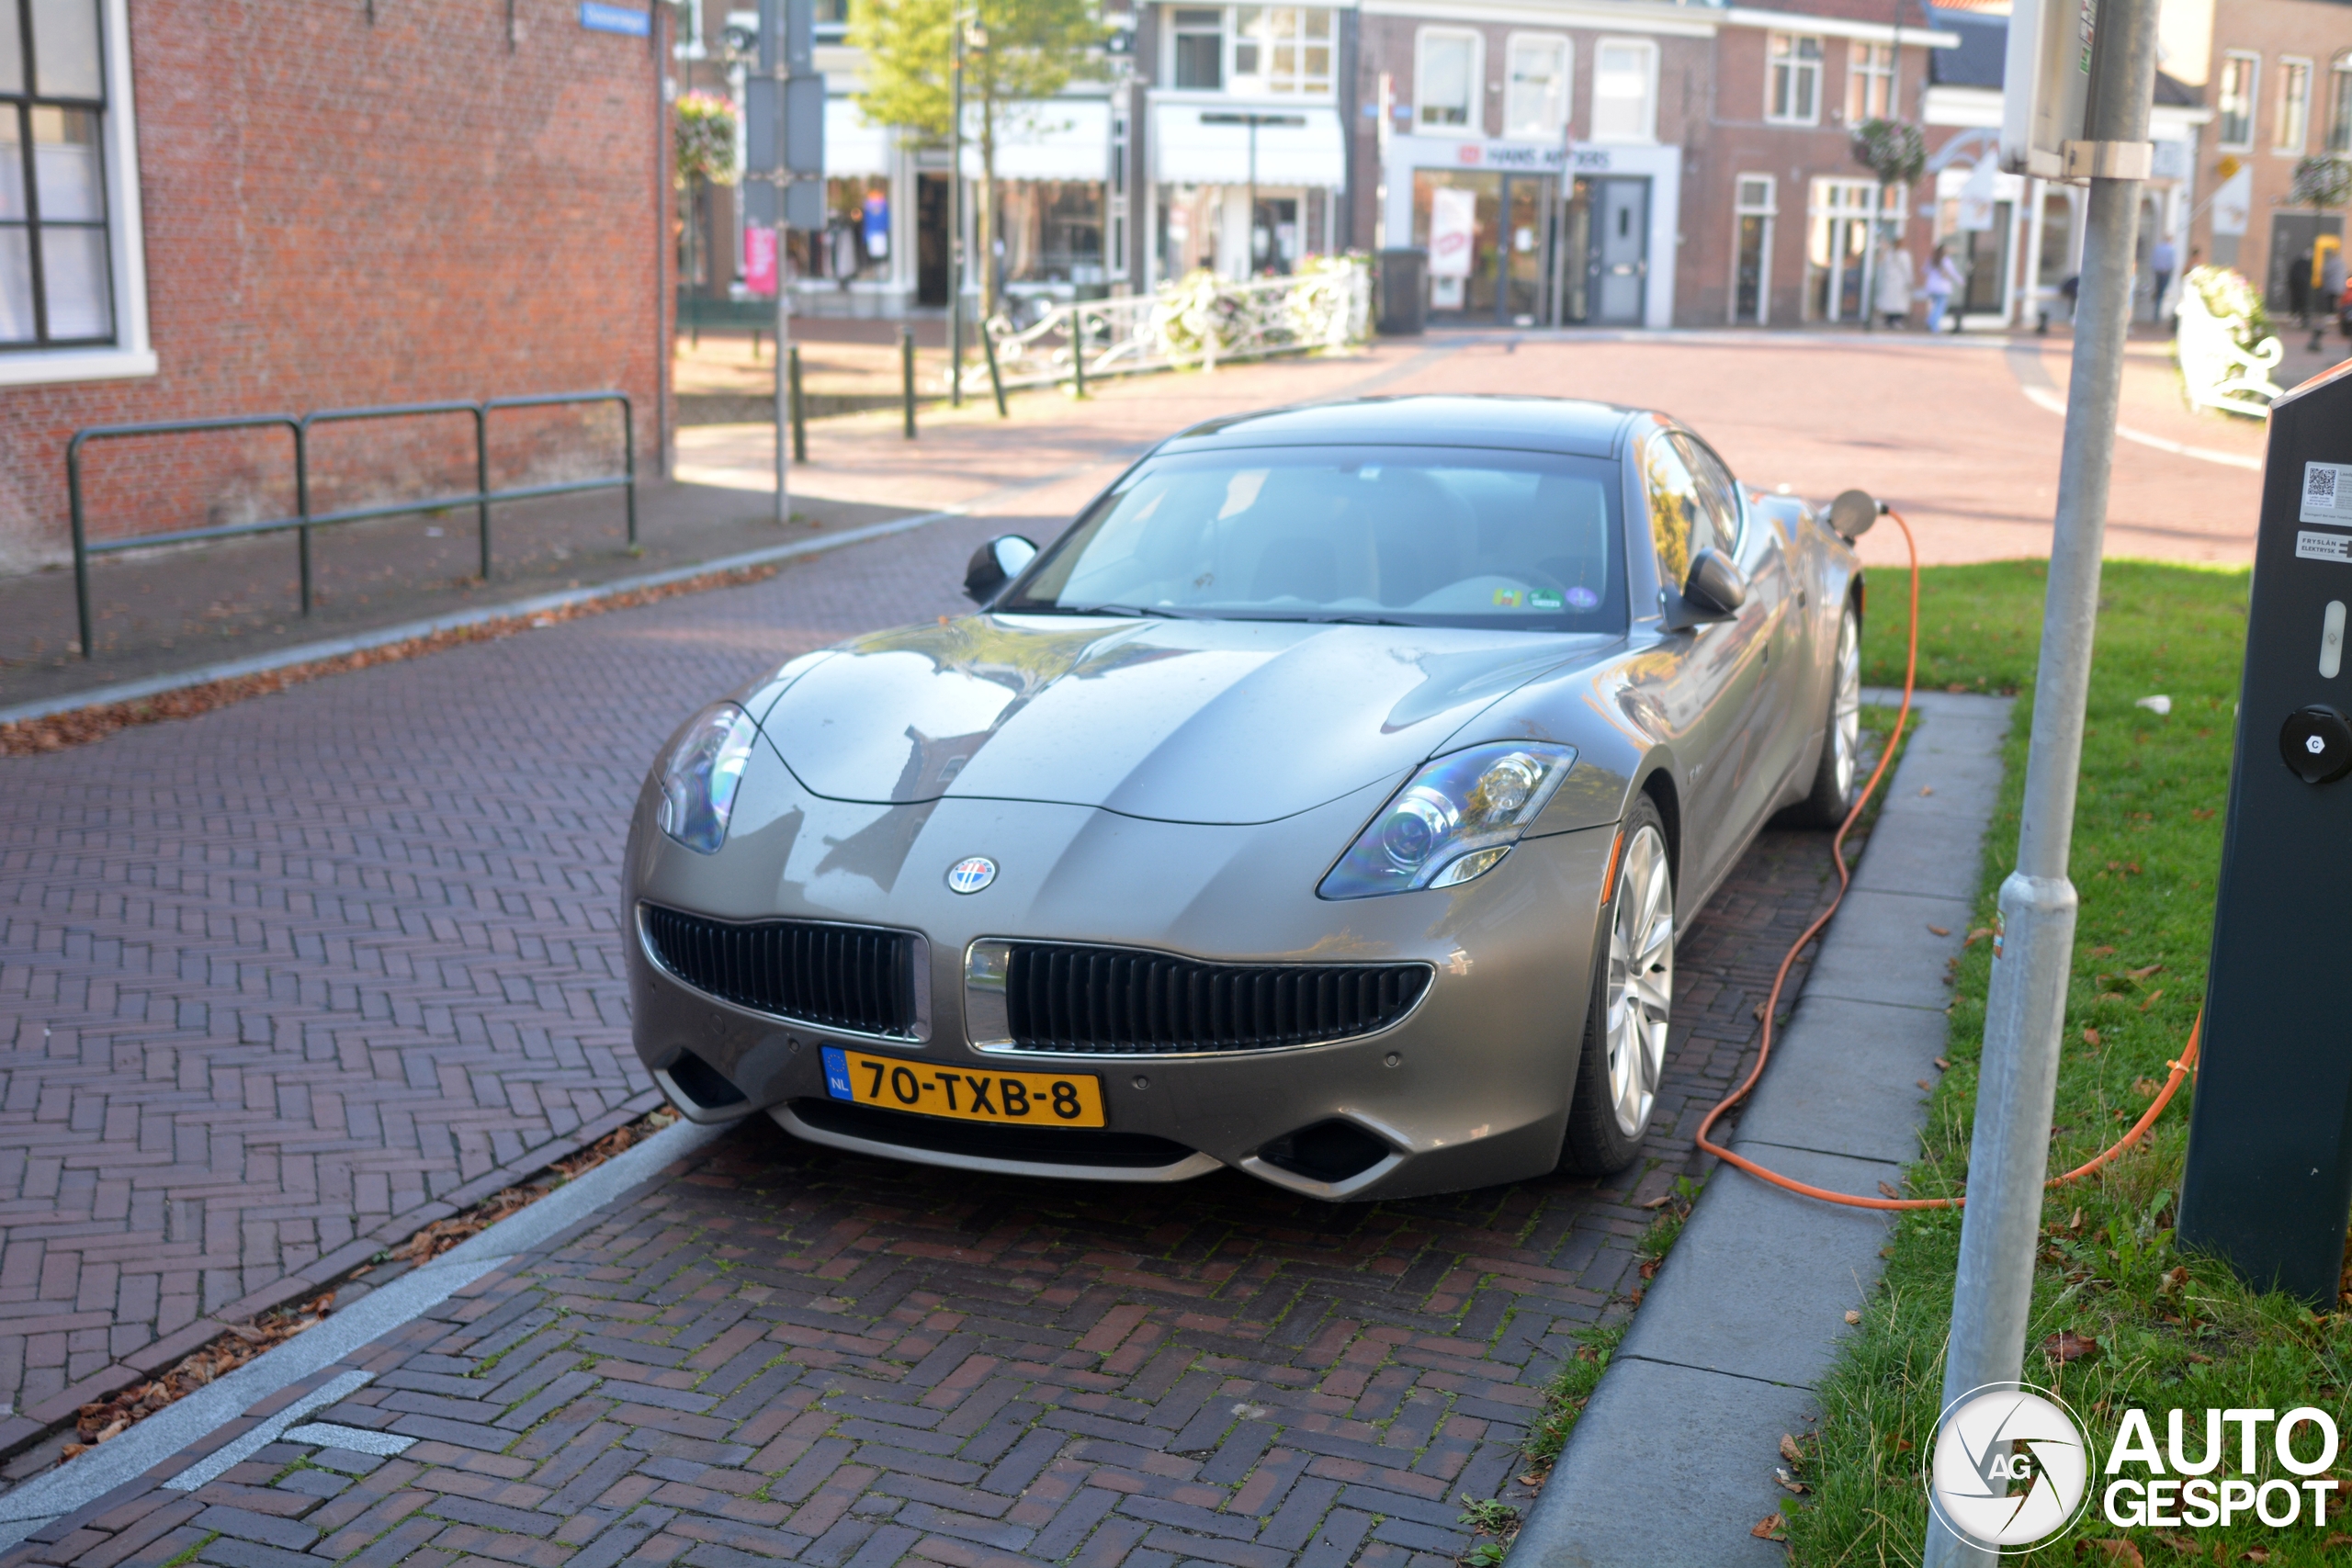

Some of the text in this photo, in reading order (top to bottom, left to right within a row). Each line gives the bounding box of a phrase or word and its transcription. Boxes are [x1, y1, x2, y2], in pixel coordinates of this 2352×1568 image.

[2301, 546, 2335, 554] ELEKTRYSK
[2312, 740, 2319, 749] C
[831, 1077, 849, 1092] NL
[860, 1060, 1082, 1120] 70-TXB-8
